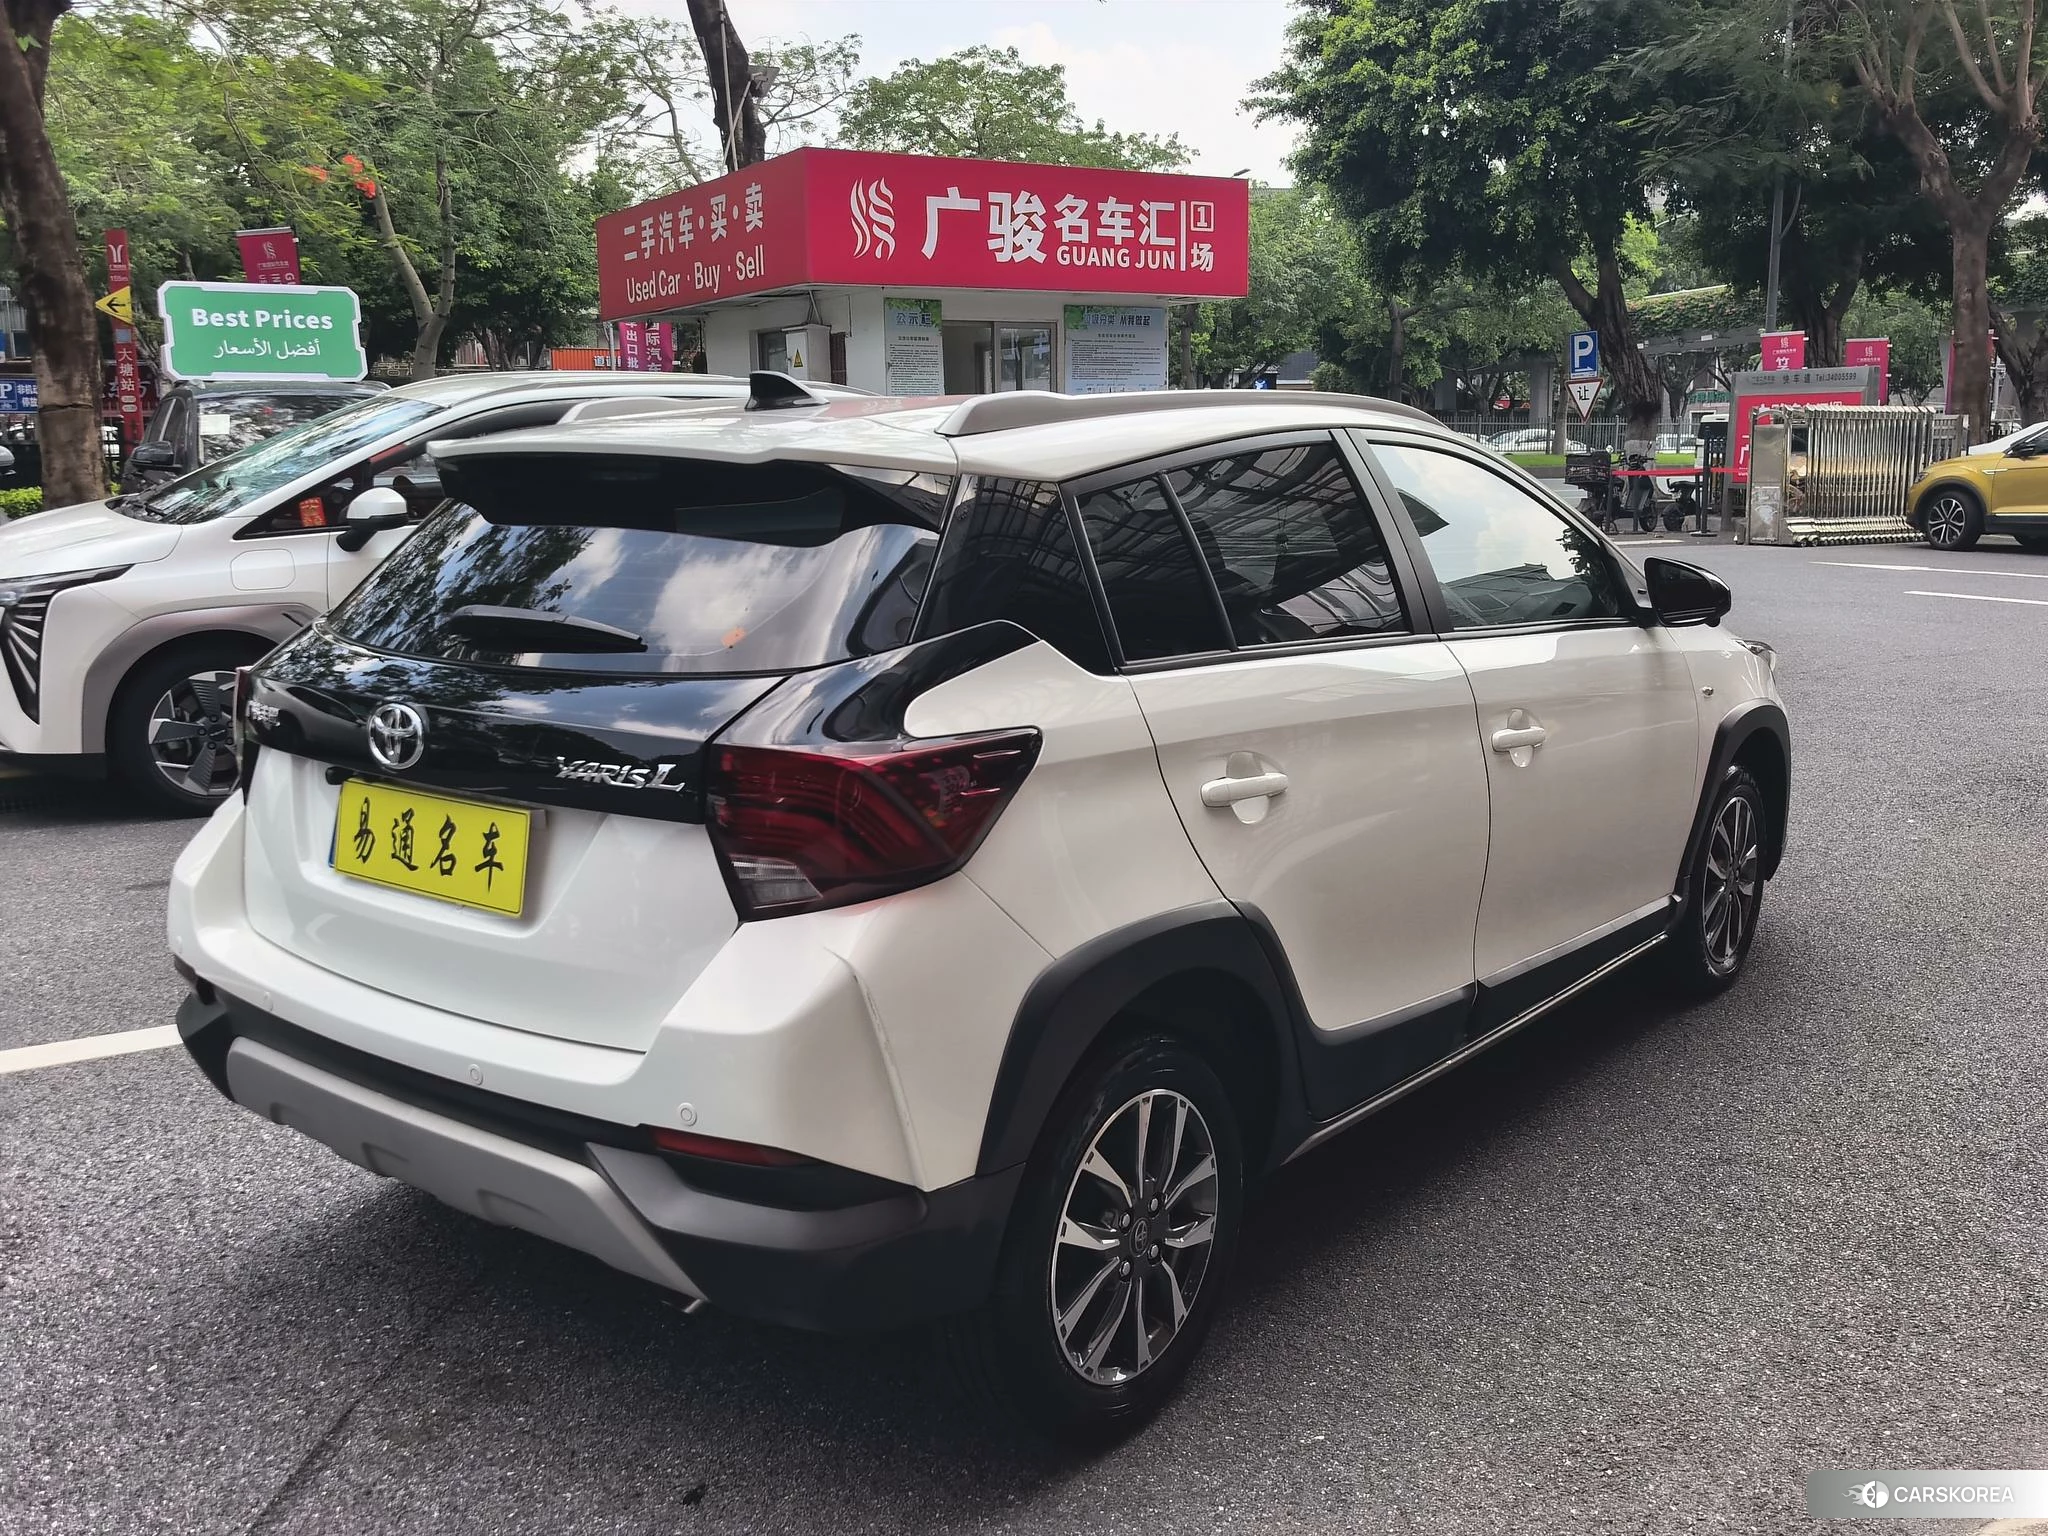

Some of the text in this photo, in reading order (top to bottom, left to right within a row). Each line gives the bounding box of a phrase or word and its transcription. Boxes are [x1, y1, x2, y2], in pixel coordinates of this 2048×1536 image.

[921, 186, 1176, 264] 广骏名车汇
[1056, 245, 1176, 270] GUANG JUN
[626, 244, 765, 304] Used Car Buy Sell
[191, 308, 333, 330] Best Prices
[213, 337, 321, 360] أفضل الأسعار
[1574, 334, 1594, 369] P
[118, 348, 135, 391] 大塘站
[0, 383, 13, 399] P
[1577, 385, 1590, 401] 让
[645, 763, 686, 792] L
[354, 796, 504, 893] 易通名车
